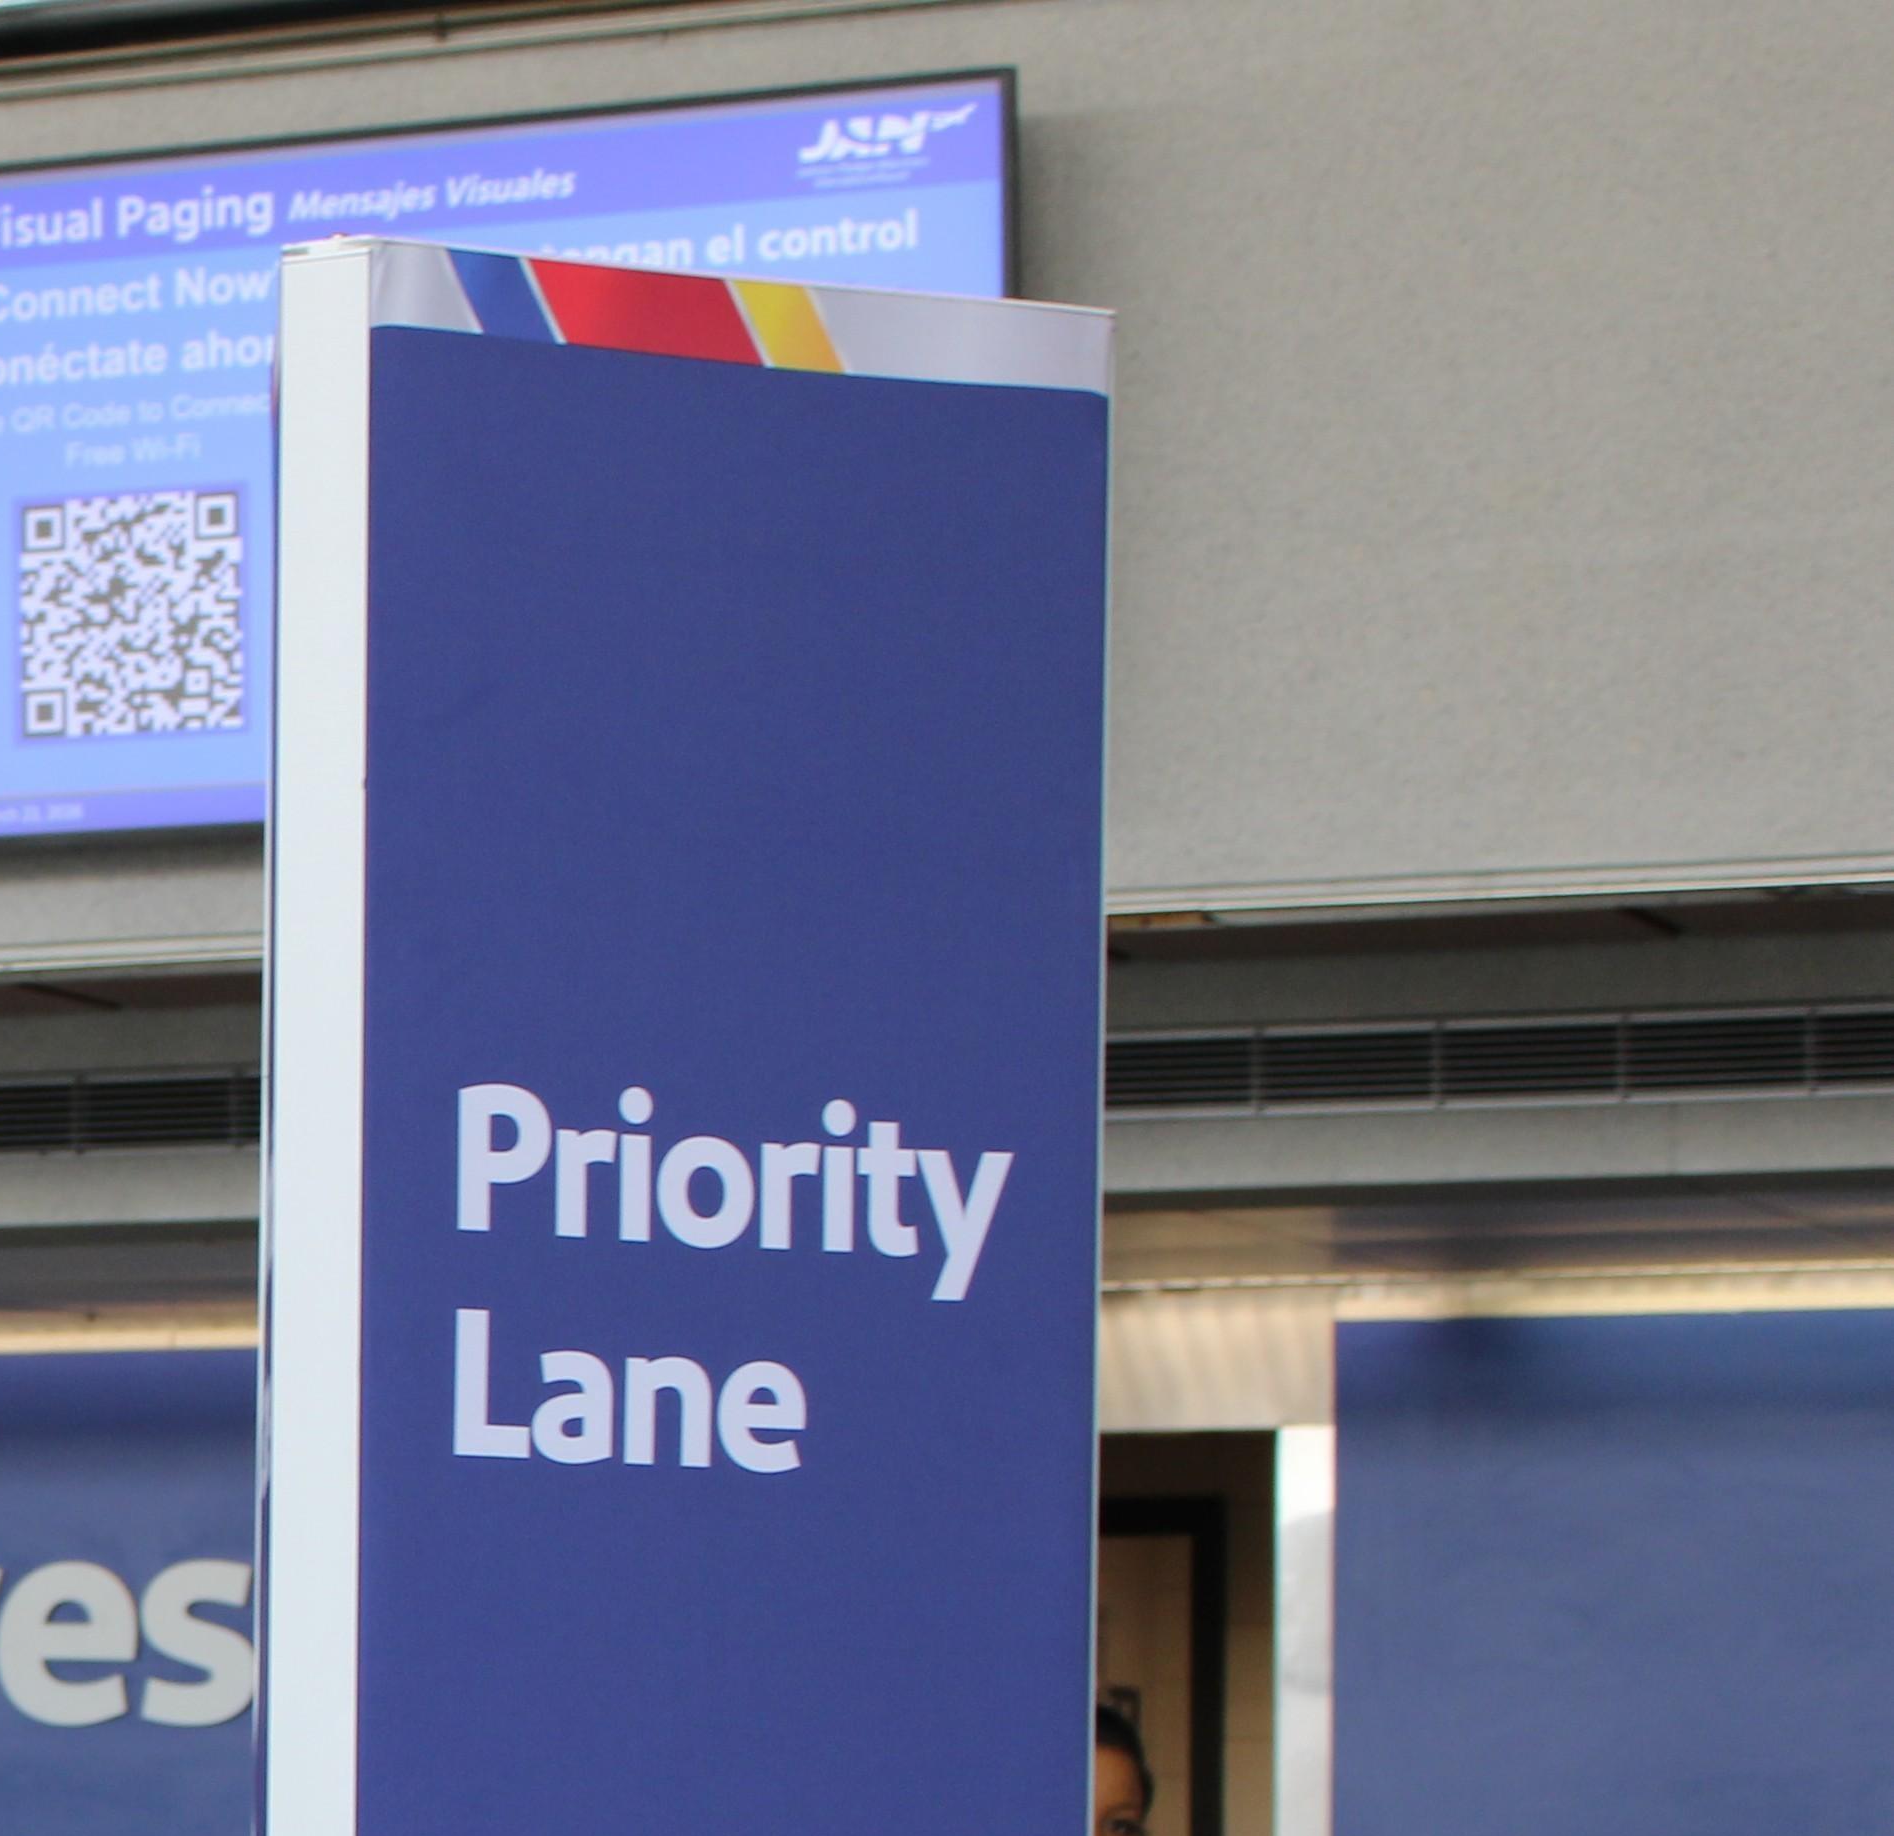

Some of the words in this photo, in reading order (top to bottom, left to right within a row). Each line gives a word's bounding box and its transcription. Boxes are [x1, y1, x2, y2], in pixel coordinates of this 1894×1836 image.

[116, 185, 275, 240] Paging
[289, 182, 436, 223] Mensajes
[445, 171, 576, 208] Visuales
[705, 222, 746, 263] el
[759, 208, 918, 259] control
[13, 404, 55, 437] QR
[63, 398, 130, 431] Code
[137, 397, 161, 425] to
[66, 440, 124, 469] Free
[457, 1083, 1014, 1301] Priority
[453, 1308, 807, 1473] Lane
